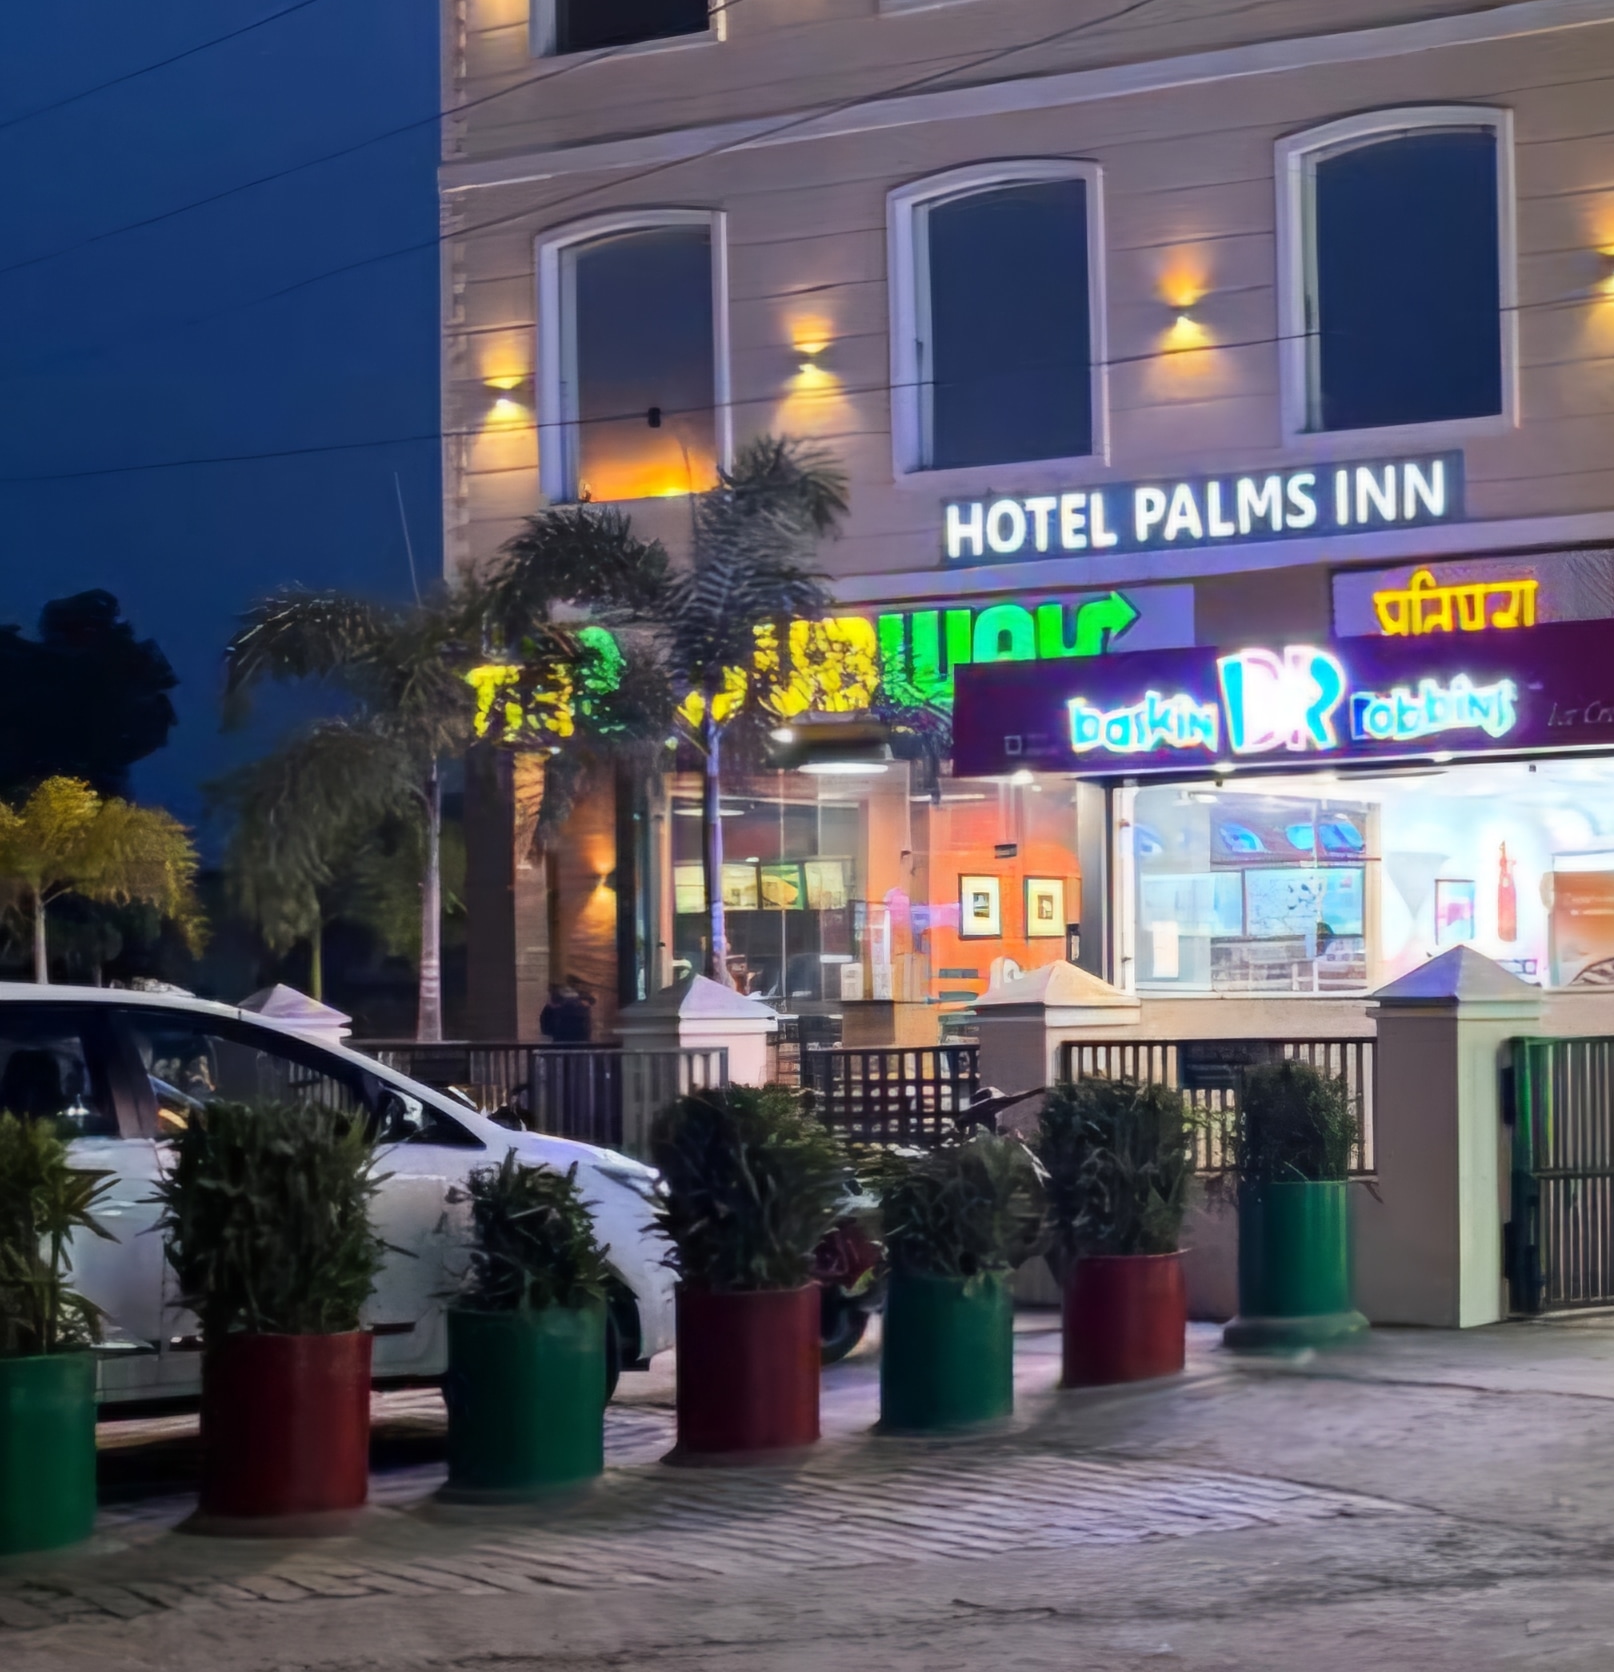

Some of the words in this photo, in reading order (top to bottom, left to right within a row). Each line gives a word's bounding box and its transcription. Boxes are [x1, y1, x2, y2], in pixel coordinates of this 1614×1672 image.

[946, 492, 1118, 559] HOTEL
[1135, 473, 1316, 542] PALMS
[1336, 459, 1445, 526] INN
[674, 590, 1141, 726] UBWAY
